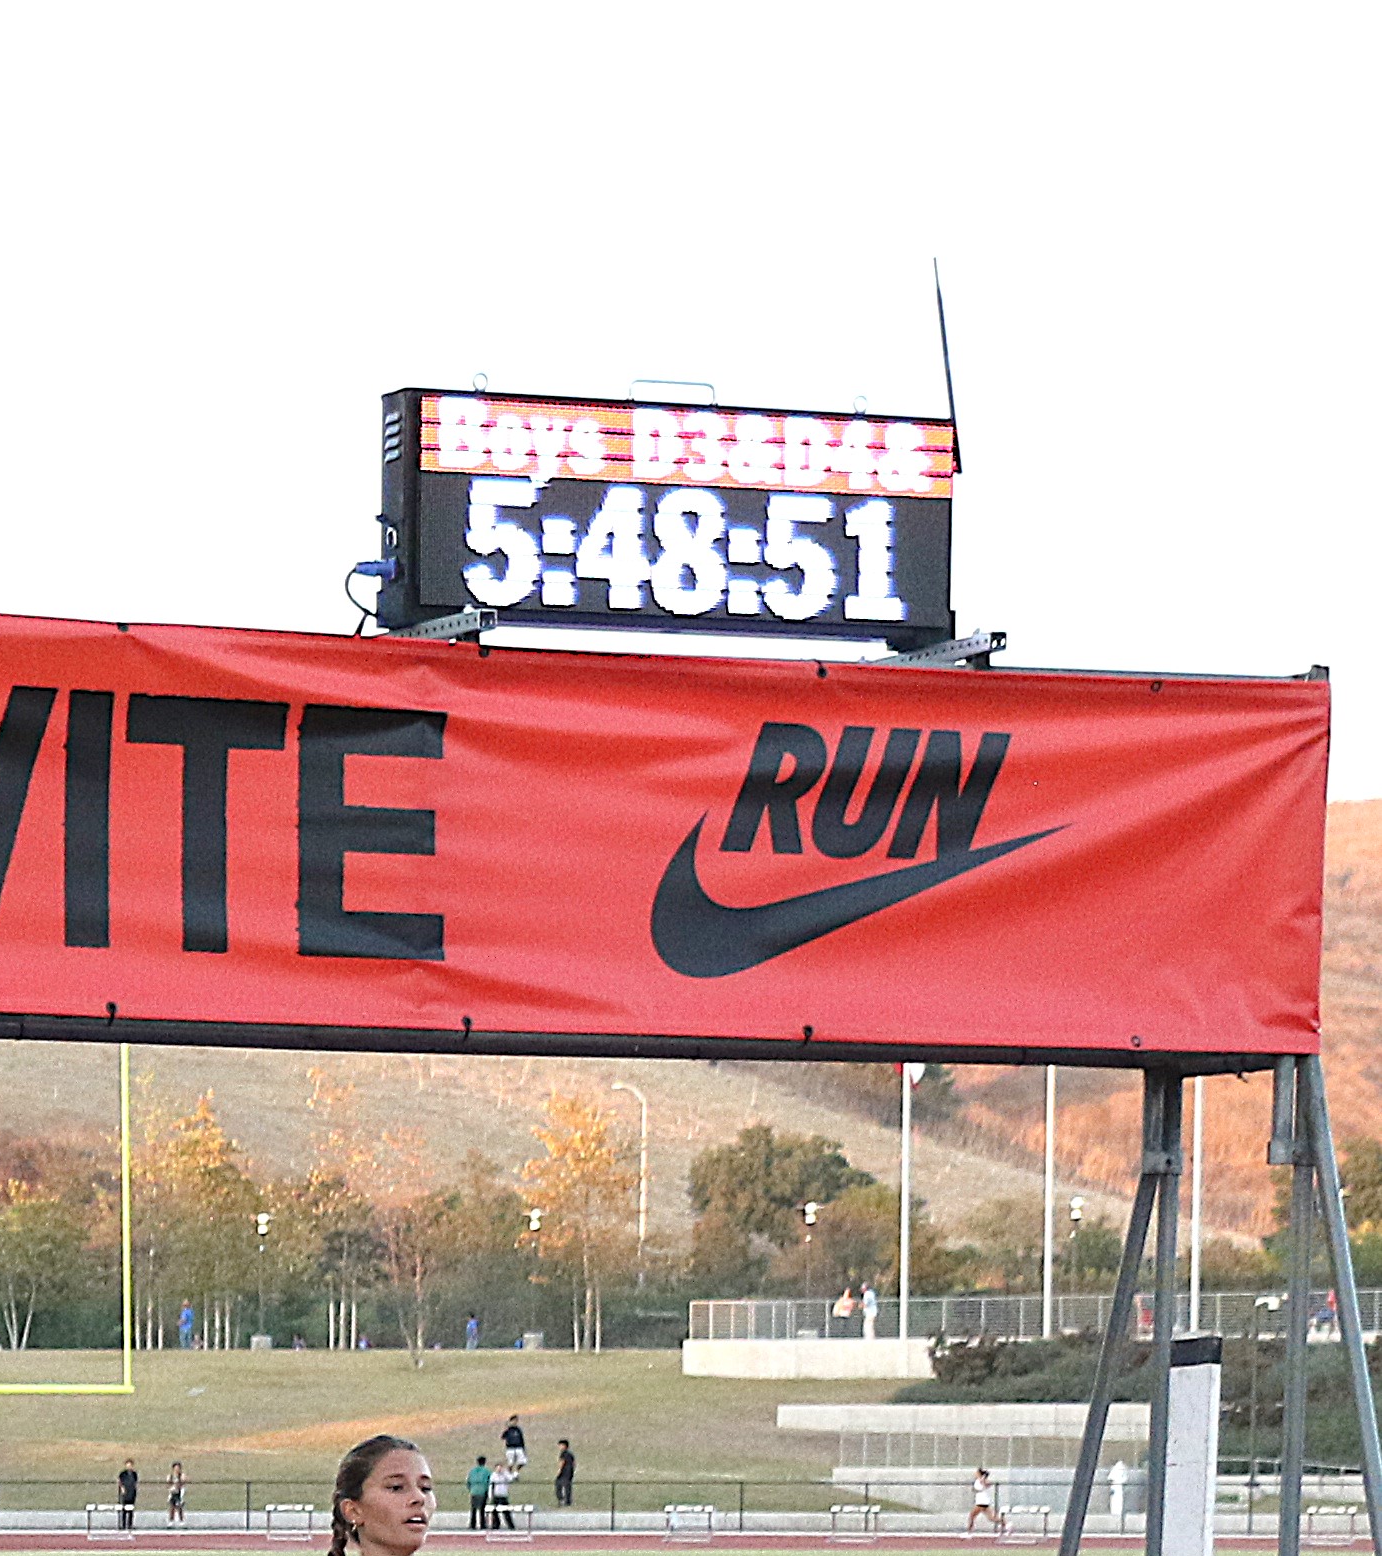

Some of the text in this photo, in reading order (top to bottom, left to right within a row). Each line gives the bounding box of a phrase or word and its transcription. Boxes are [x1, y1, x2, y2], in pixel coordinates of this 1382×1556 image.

[438, 395, 606, 487] Boys
[462, 476, 908, 621] 5:48:51
[718, 721, 1012, 860] RUN
